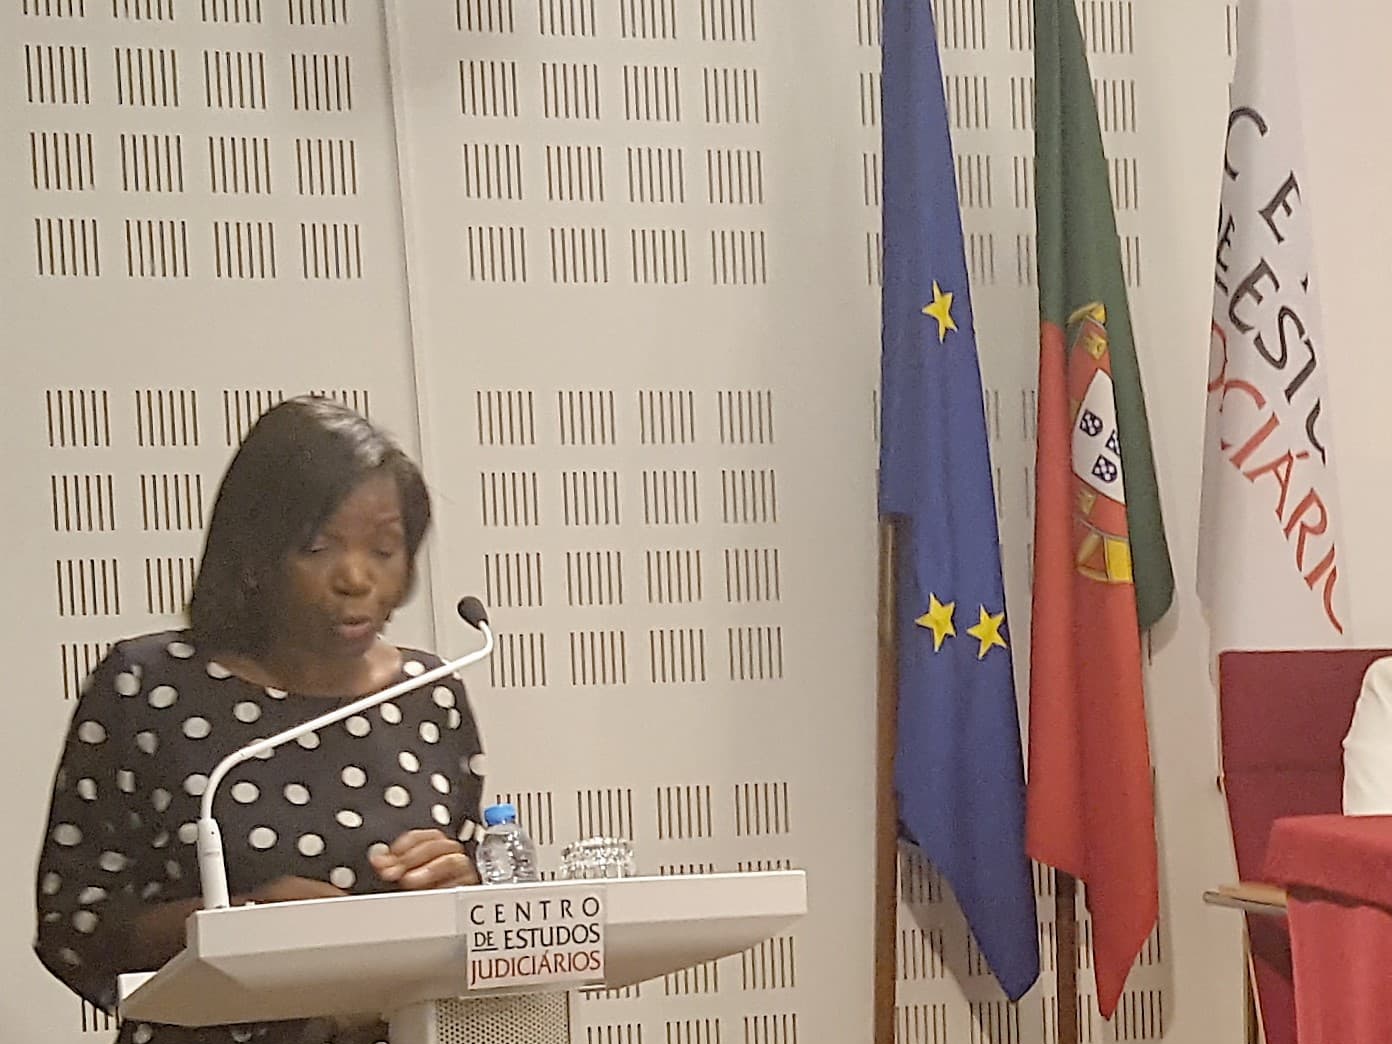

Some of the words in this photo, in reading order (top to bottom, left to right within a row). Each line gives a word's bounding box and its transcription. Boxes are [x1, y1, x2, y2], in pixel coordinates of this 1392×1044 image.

[470, 897, 600, 925] CENTRO
[474, 931, 494, 947] DE
[504, 922, 600, 950] ESTUDOS
[470, 949, 601, 985] JUDICIÁRIOS
